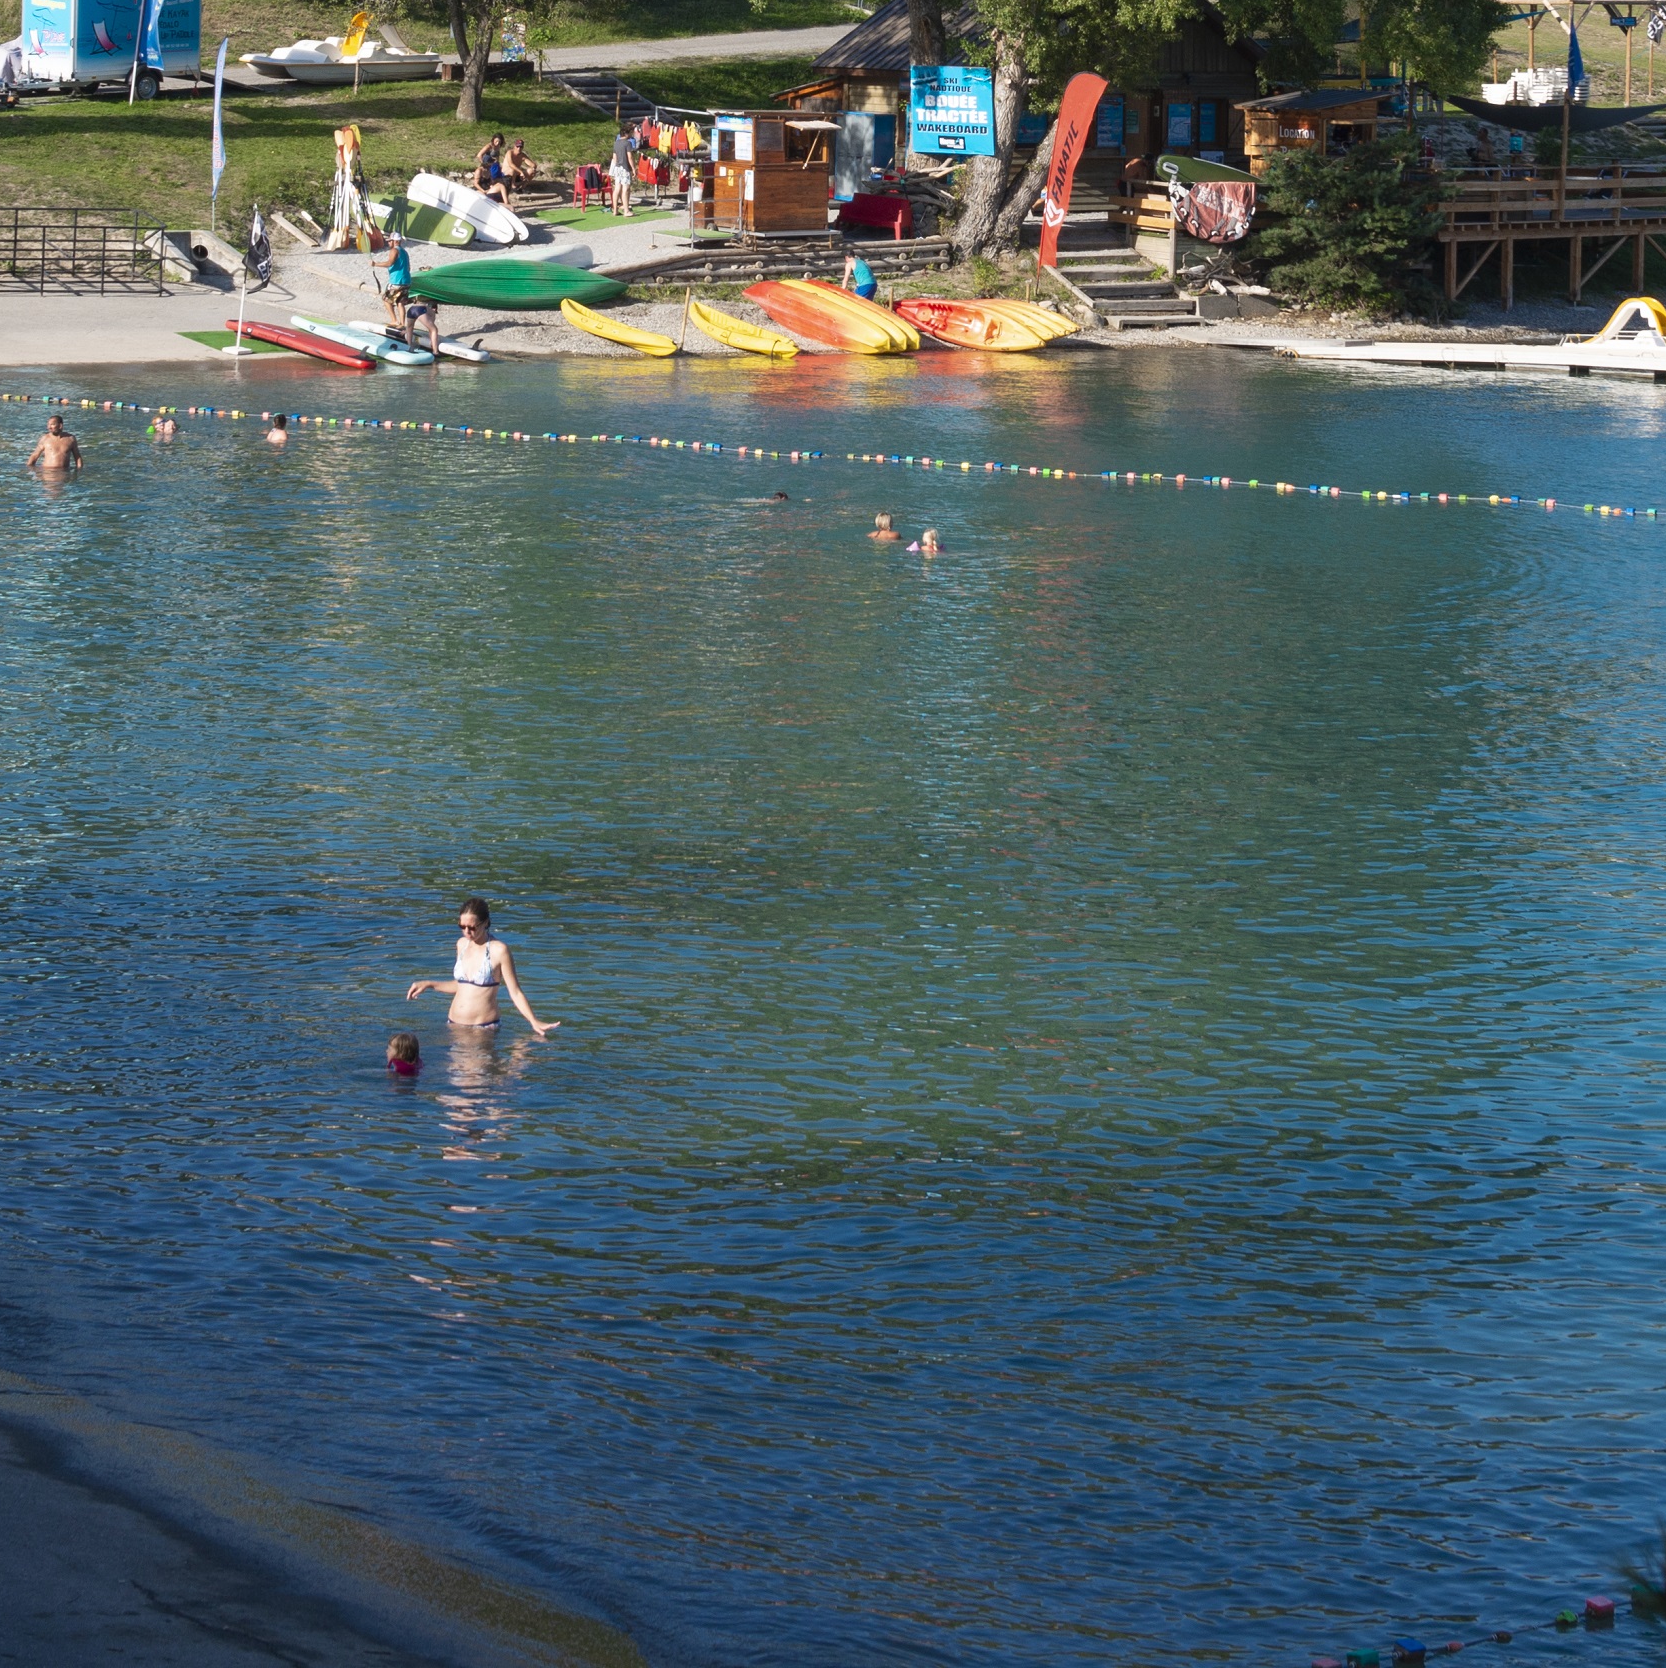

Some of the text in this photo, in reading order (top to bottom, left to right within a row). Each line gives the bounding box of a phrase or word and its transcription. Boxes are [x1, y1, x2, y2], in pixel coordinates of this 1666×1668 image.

[929, 84, 972, 93] NAUTIQUE
[925, 94, 977, 108] BOUÉE
[916, 107, 987, 123] TRACTÉE
[916, 123, 988, 134] WAKEBOARD
[1051, 120, 1079, 204] FANATIC
